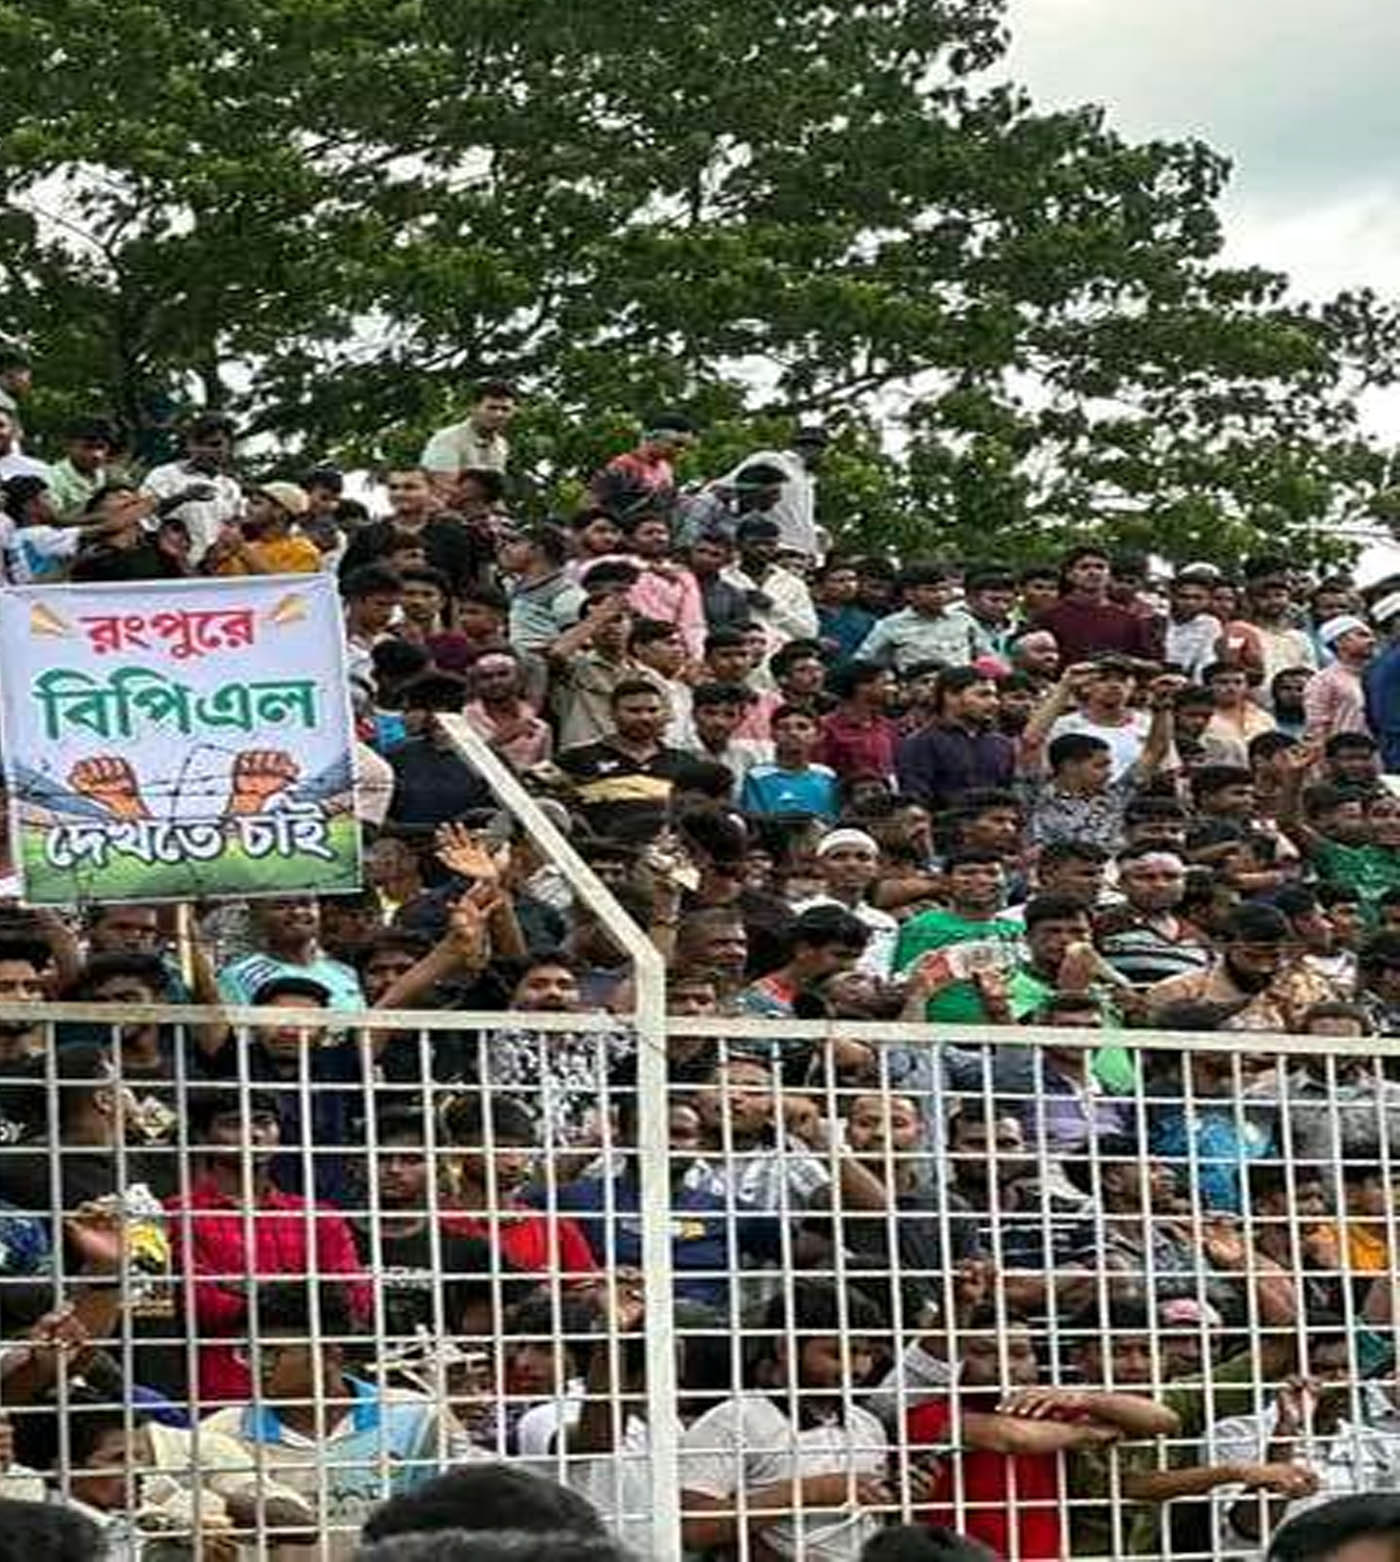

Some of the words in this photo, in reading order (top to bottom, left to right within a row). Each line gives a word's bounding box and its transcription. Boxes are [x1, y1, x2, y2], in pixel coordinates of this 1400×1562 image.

[81, 609, 255, 658] রংপুরে
[32, 666, 317, 740] বিপিএল
[47, 817, 224, 868] দেখতে
[242, 793, 334, 861] চাই
